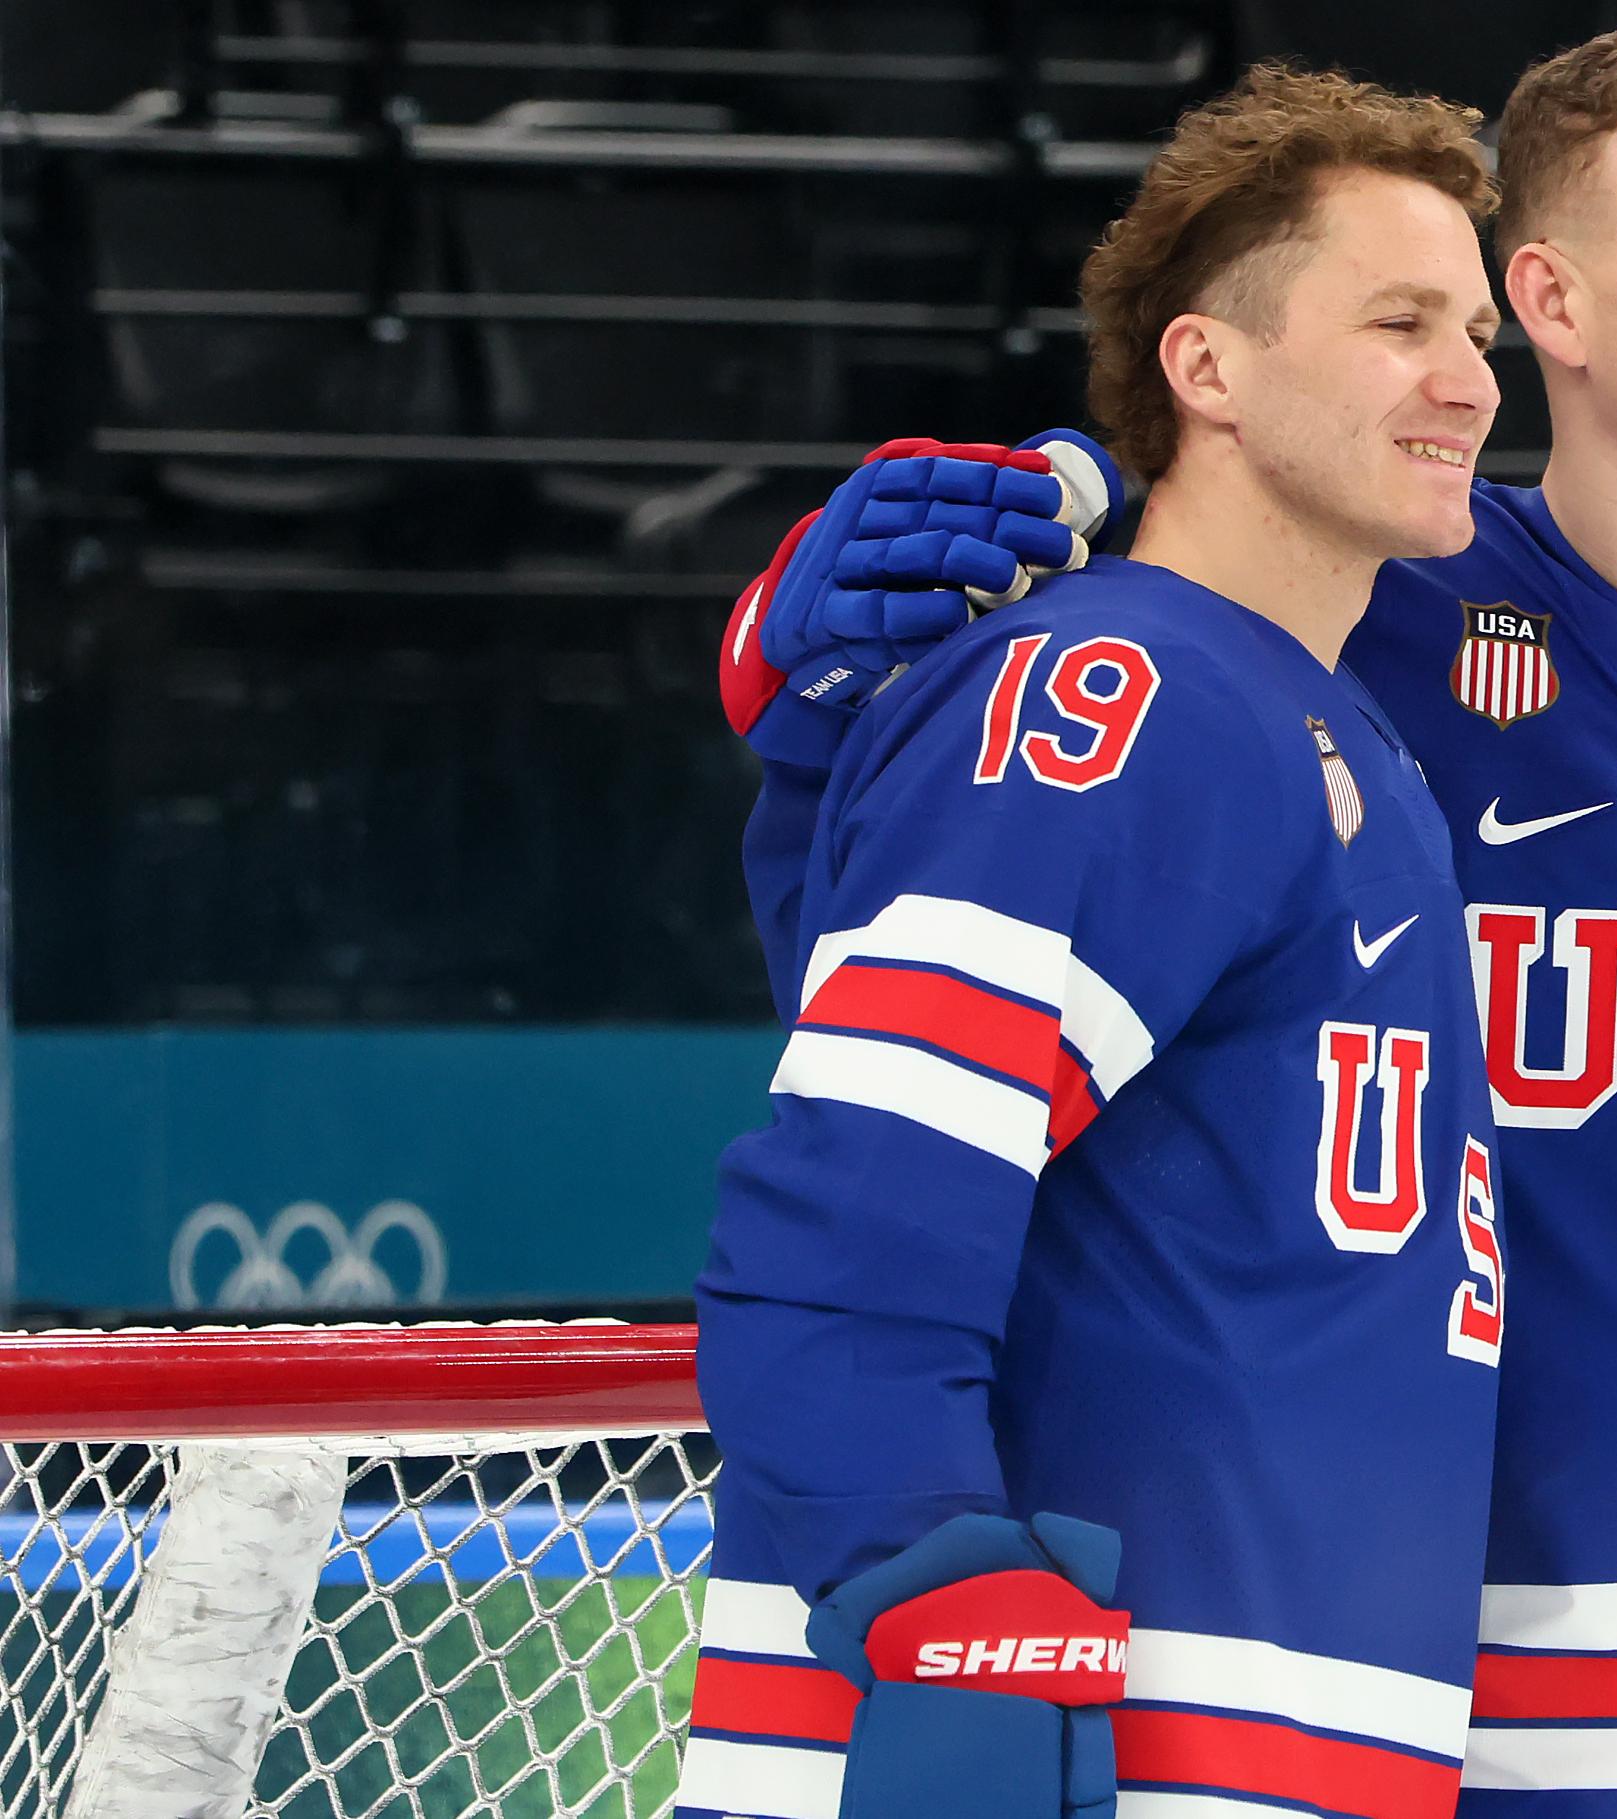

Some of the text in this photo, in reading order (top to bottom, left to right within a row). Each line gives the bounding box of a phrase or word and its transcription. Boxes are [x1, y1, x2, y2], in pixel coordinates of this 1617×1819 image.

[1477, 611, 1536, 640] USA
[799, 667, 854, 700] TEAM USA
[973, 632, 1162, 793] 19
